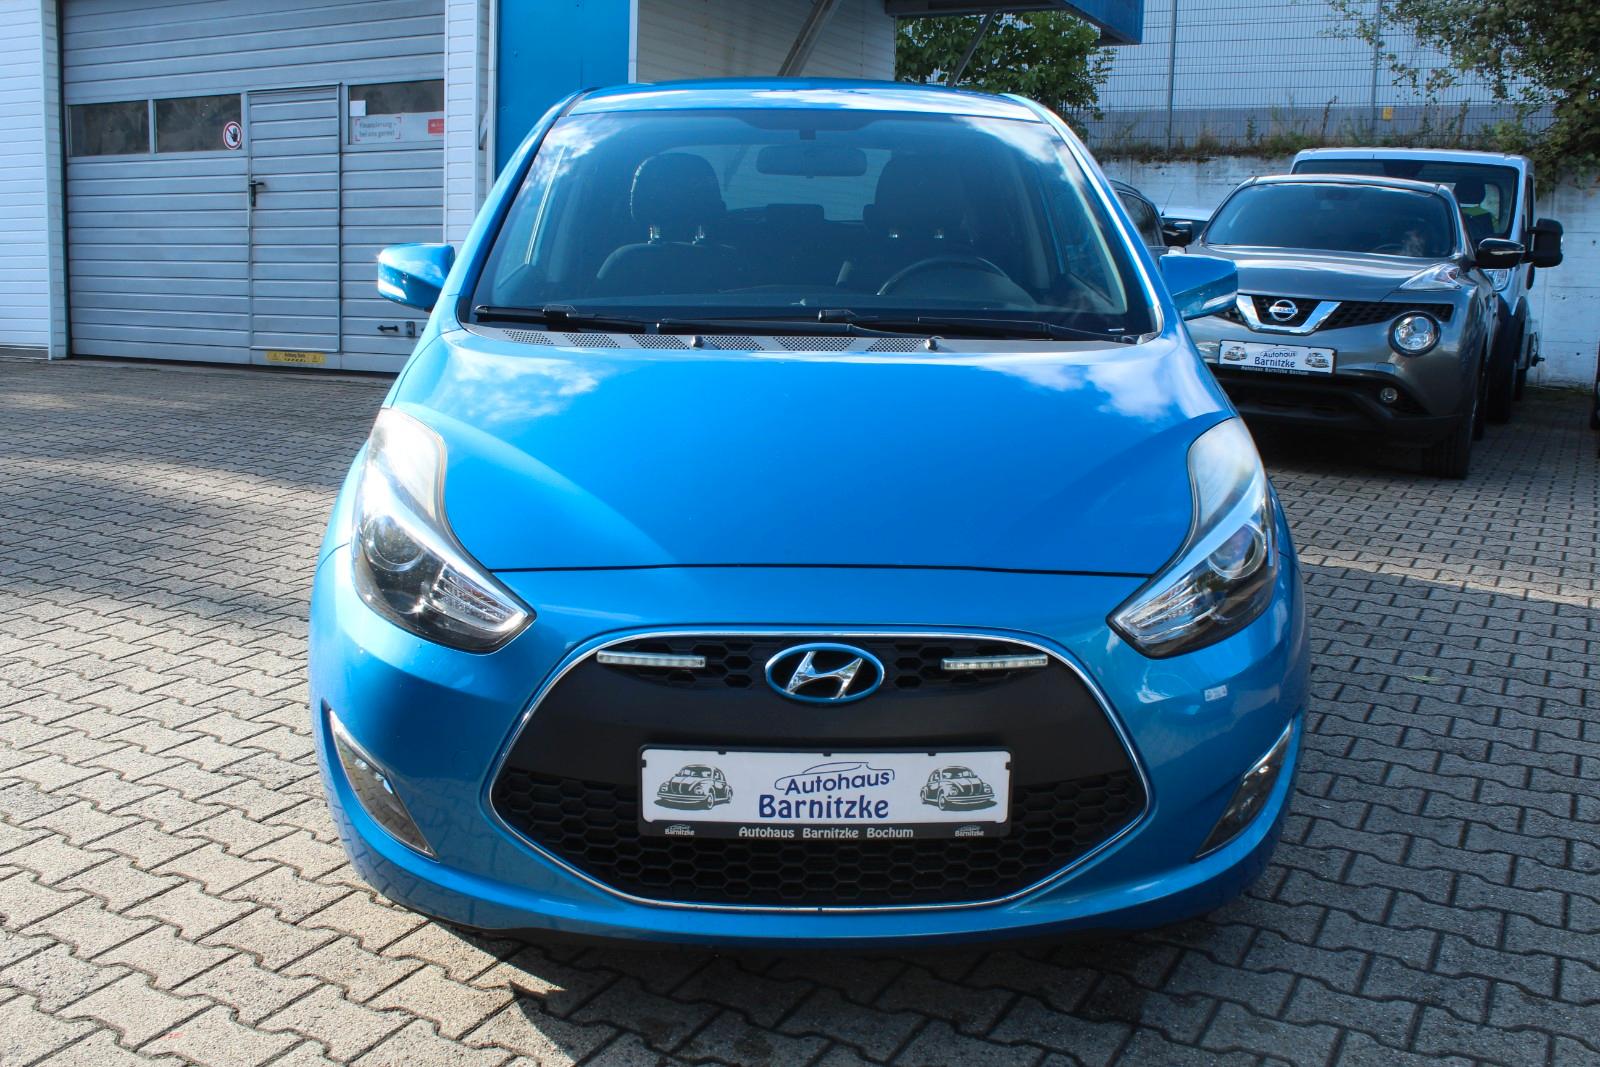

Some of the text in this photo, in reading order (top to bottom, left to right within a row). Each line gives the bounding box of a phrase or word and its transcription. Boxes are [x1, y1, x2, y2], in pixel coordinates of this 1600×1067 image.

[1263, 350, 1296, 358] Autohaus
[1254, 356, 1296, 368] Barnitzke
[784, 772, 890, 796] Autohaus
[758, 794, 889, 819] Barnitzke
[738, 826, 914, 839] Autohaus Barnitzke Bochum
